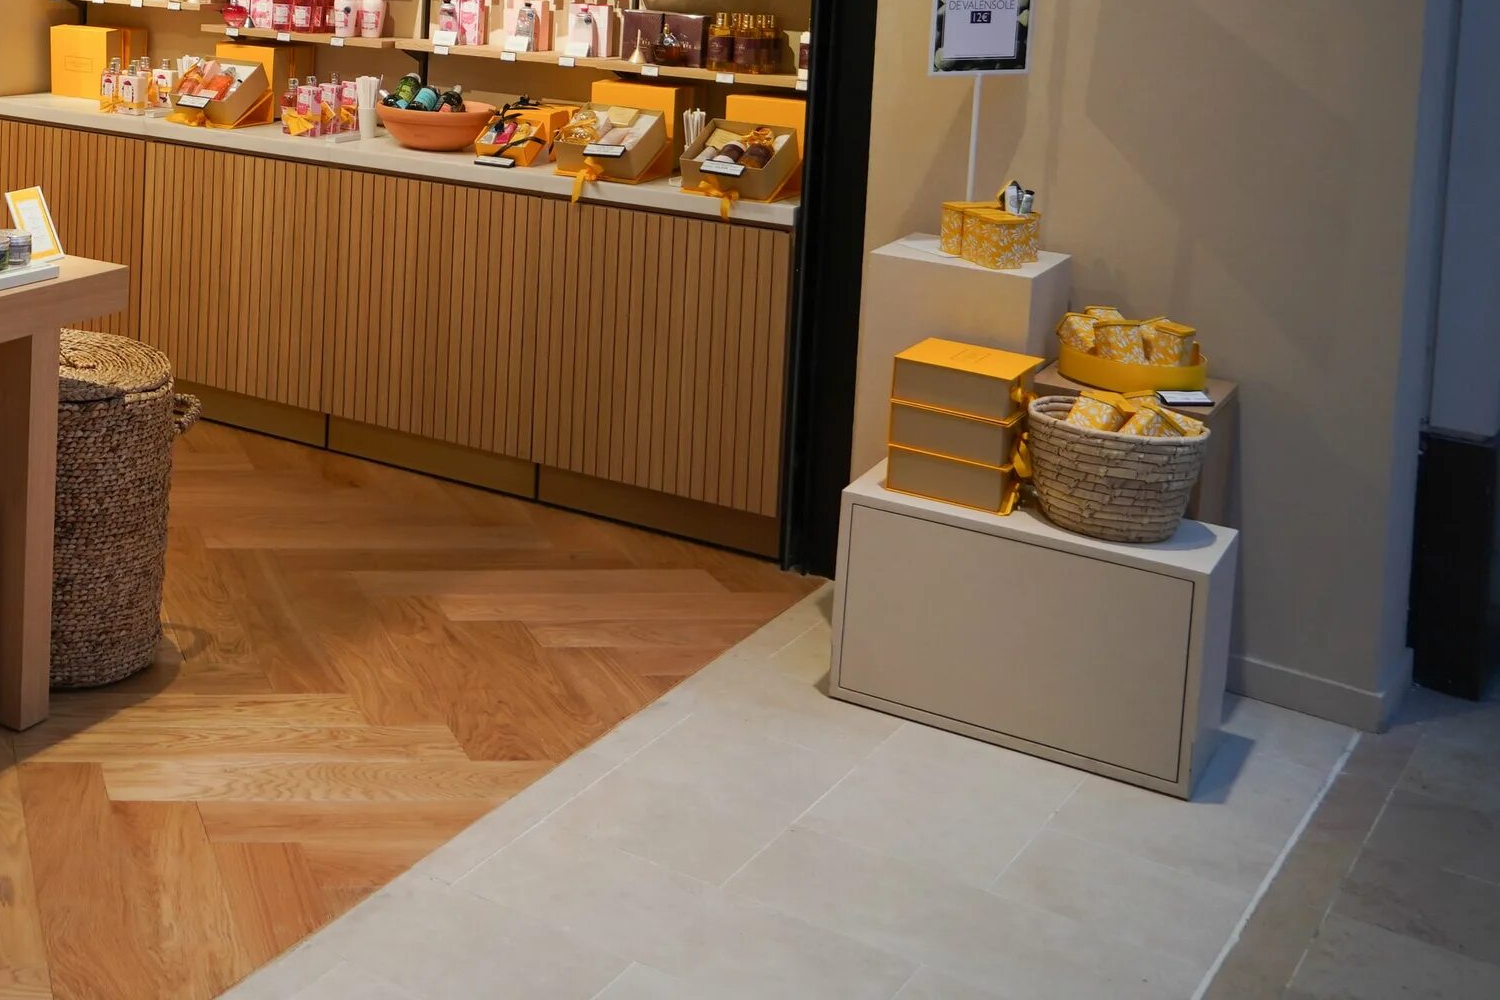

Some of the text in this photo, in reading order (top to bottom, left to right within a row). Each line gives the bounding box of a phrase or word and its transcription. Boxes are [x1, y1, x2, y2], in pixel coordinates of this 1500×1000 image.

[949, 0, 1015, 10] DE VALENSOLE
[972, 12, 989, 22] 12€
